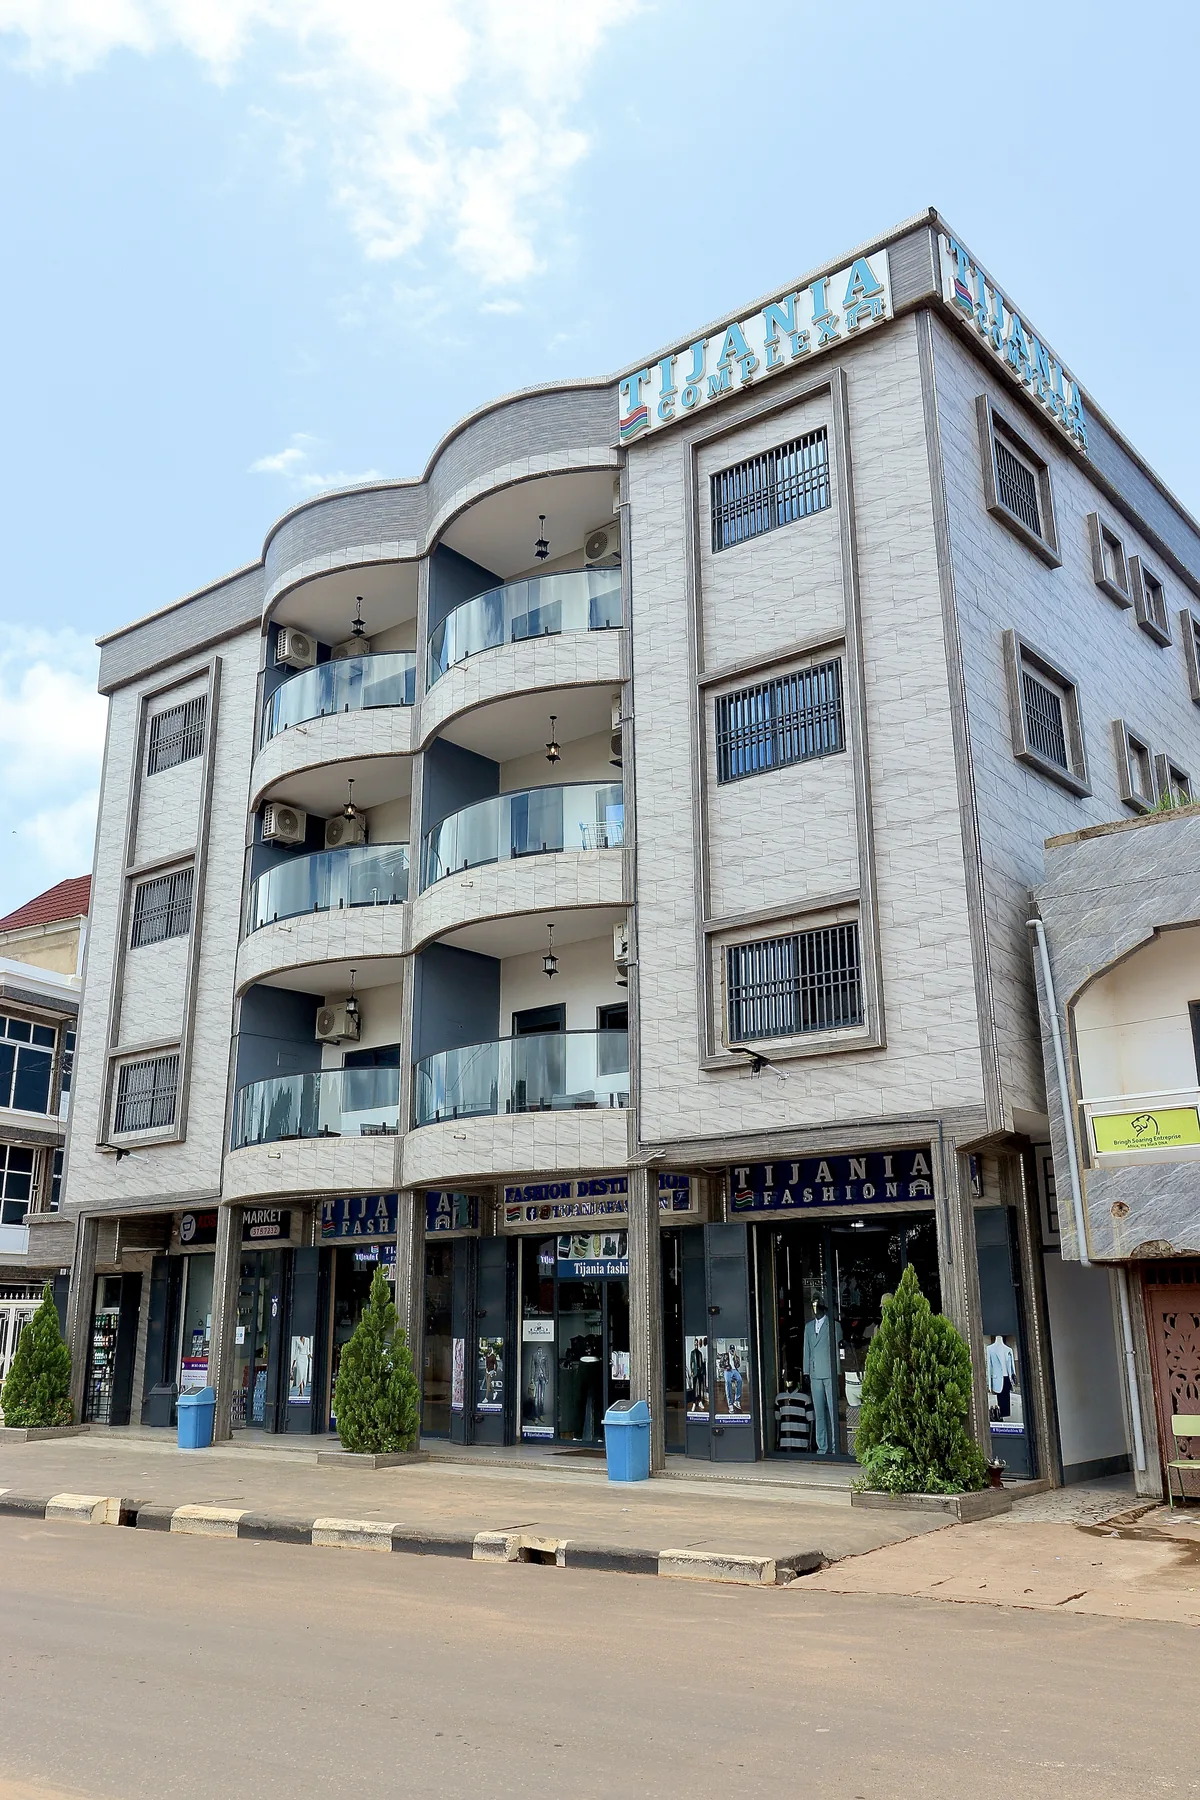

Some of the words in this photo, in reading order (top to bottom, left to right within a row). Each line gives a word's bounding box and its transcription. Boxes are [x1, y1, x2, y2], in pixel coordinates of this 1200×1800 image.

[620, 256, 885, 415] TIJANIA
[947, 237, 1086, 427] TIJANIA
[657, 315, 841, 422] COMPLEX
[735, 1152, 930, 1189] TIJANIA
[505, 1182, 573, 1204] FASHION
[576, 1173, 690, 1198] DESTIION
[763, 1182, 898, 1206] FASHION
[242, 1209, 282, 1225] MARKET
[323, 1192, 452, 1221] TIJAA
[341, 1215, 429, 1236] FASHI
[574, 1262, 604, 1277] Tijania
[606, 1261, 628, 1275] fashi
